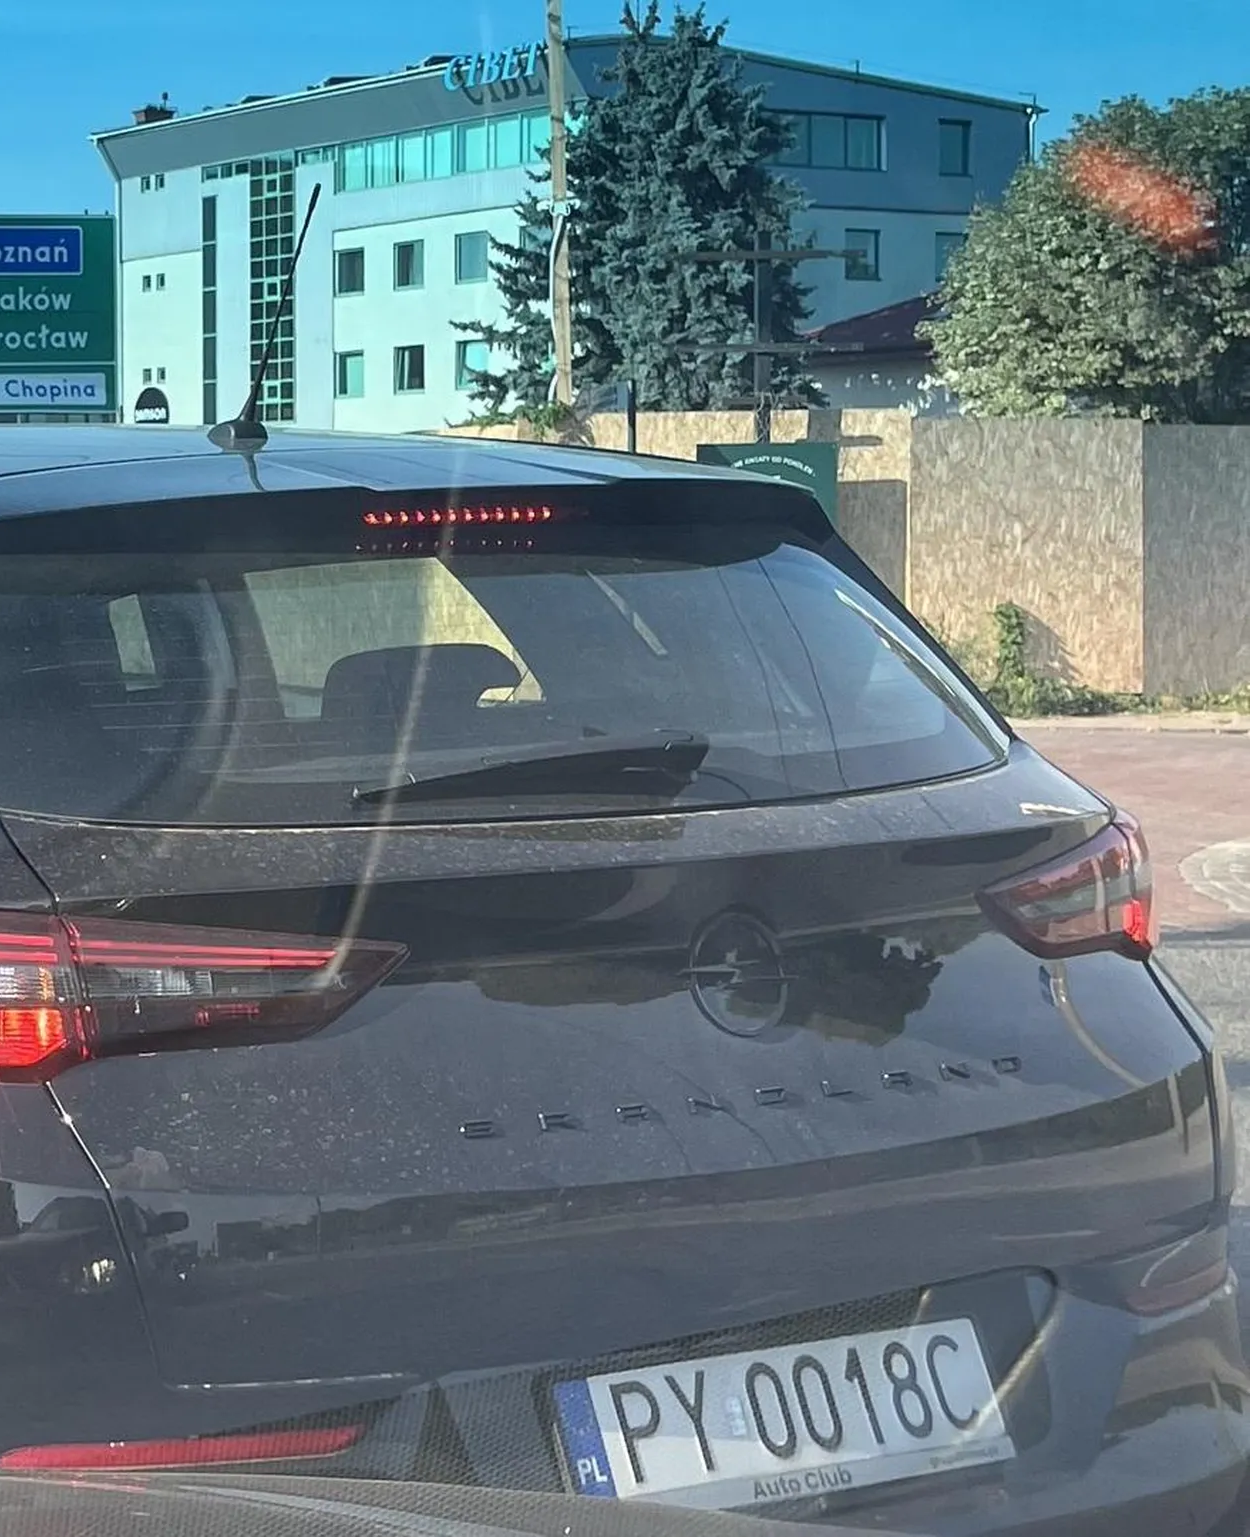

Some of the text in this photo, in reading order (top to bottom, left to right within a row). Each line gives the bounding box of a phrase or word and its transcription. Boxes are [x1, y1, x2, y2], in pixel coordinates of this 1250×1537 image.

[444, 40, 547, 91] CIBET
[4, 379, 96, 402] Chopina
[577, 1334, 979, 1484] PL PY 0018C
[753, 1468, 852, 1500] Auto Club
